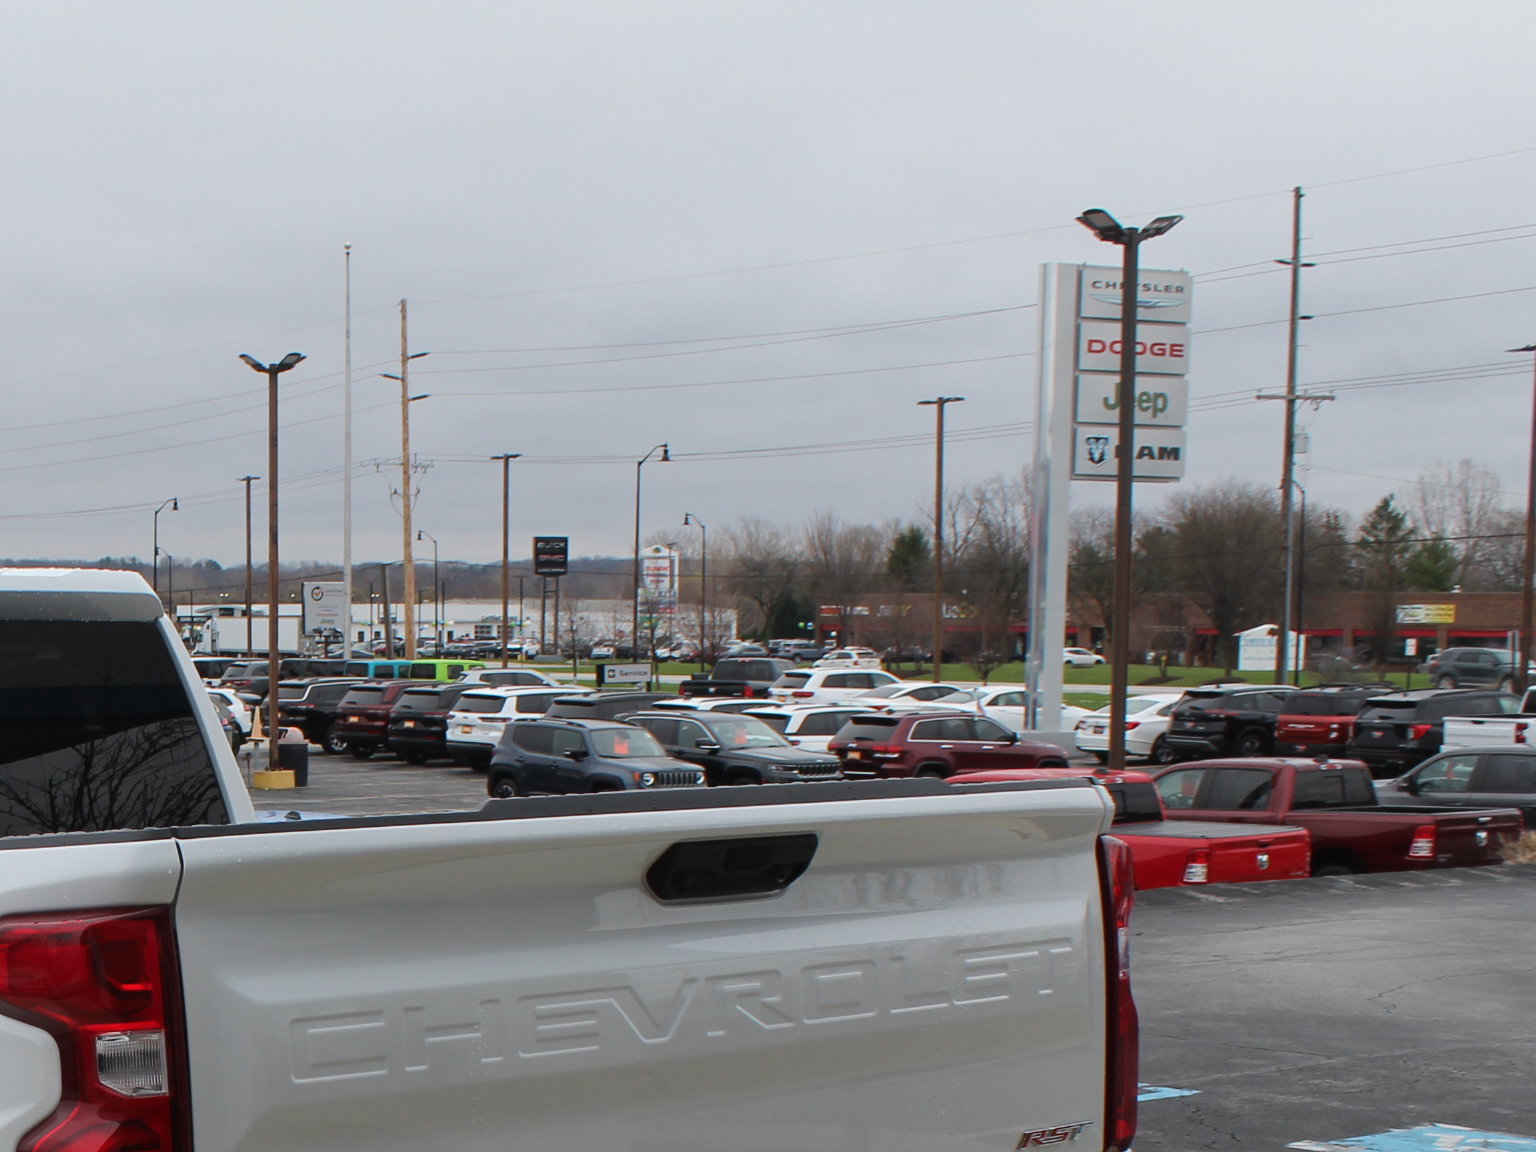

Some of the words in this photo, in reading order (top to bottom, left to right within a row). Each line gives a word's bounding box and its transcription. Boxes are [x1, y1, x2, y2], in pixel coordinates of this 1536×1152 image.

[1091, 280, 1185, 294] CHSLER
[1103, 382, 1168, 418] Jep
[1114, 444, 1181, 460] AM
[288, 937, 1075, 1086] CHEVROLET
[1015, 1121, 1094, 1152] RST
